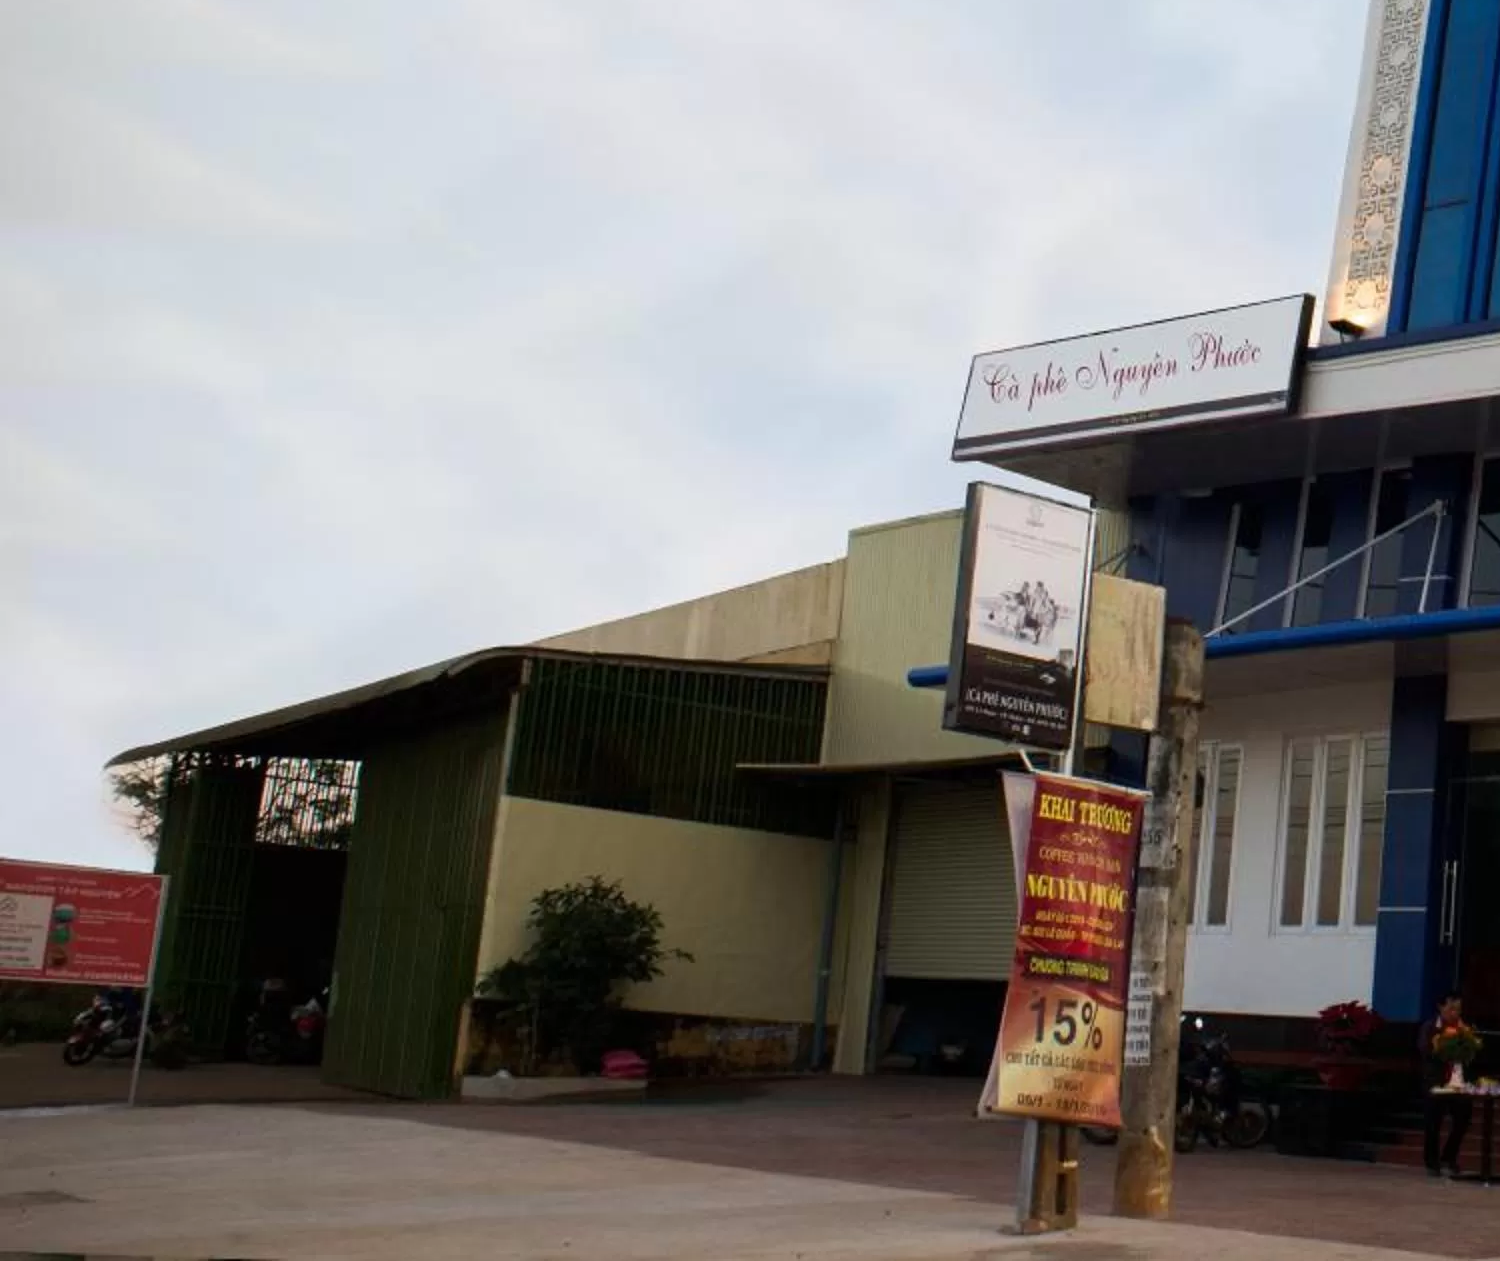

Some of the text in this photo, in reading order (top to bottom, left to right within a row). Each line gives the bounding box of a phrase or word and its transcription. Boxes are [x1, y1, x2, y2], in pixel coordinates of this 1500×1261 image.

[982, 364, 1020, 405] Cà
[1027, 362, 1068, 412] phê
[1040, 794, 1076, 823] KHAI
[1030, 996, 1103, 1051] 15%
